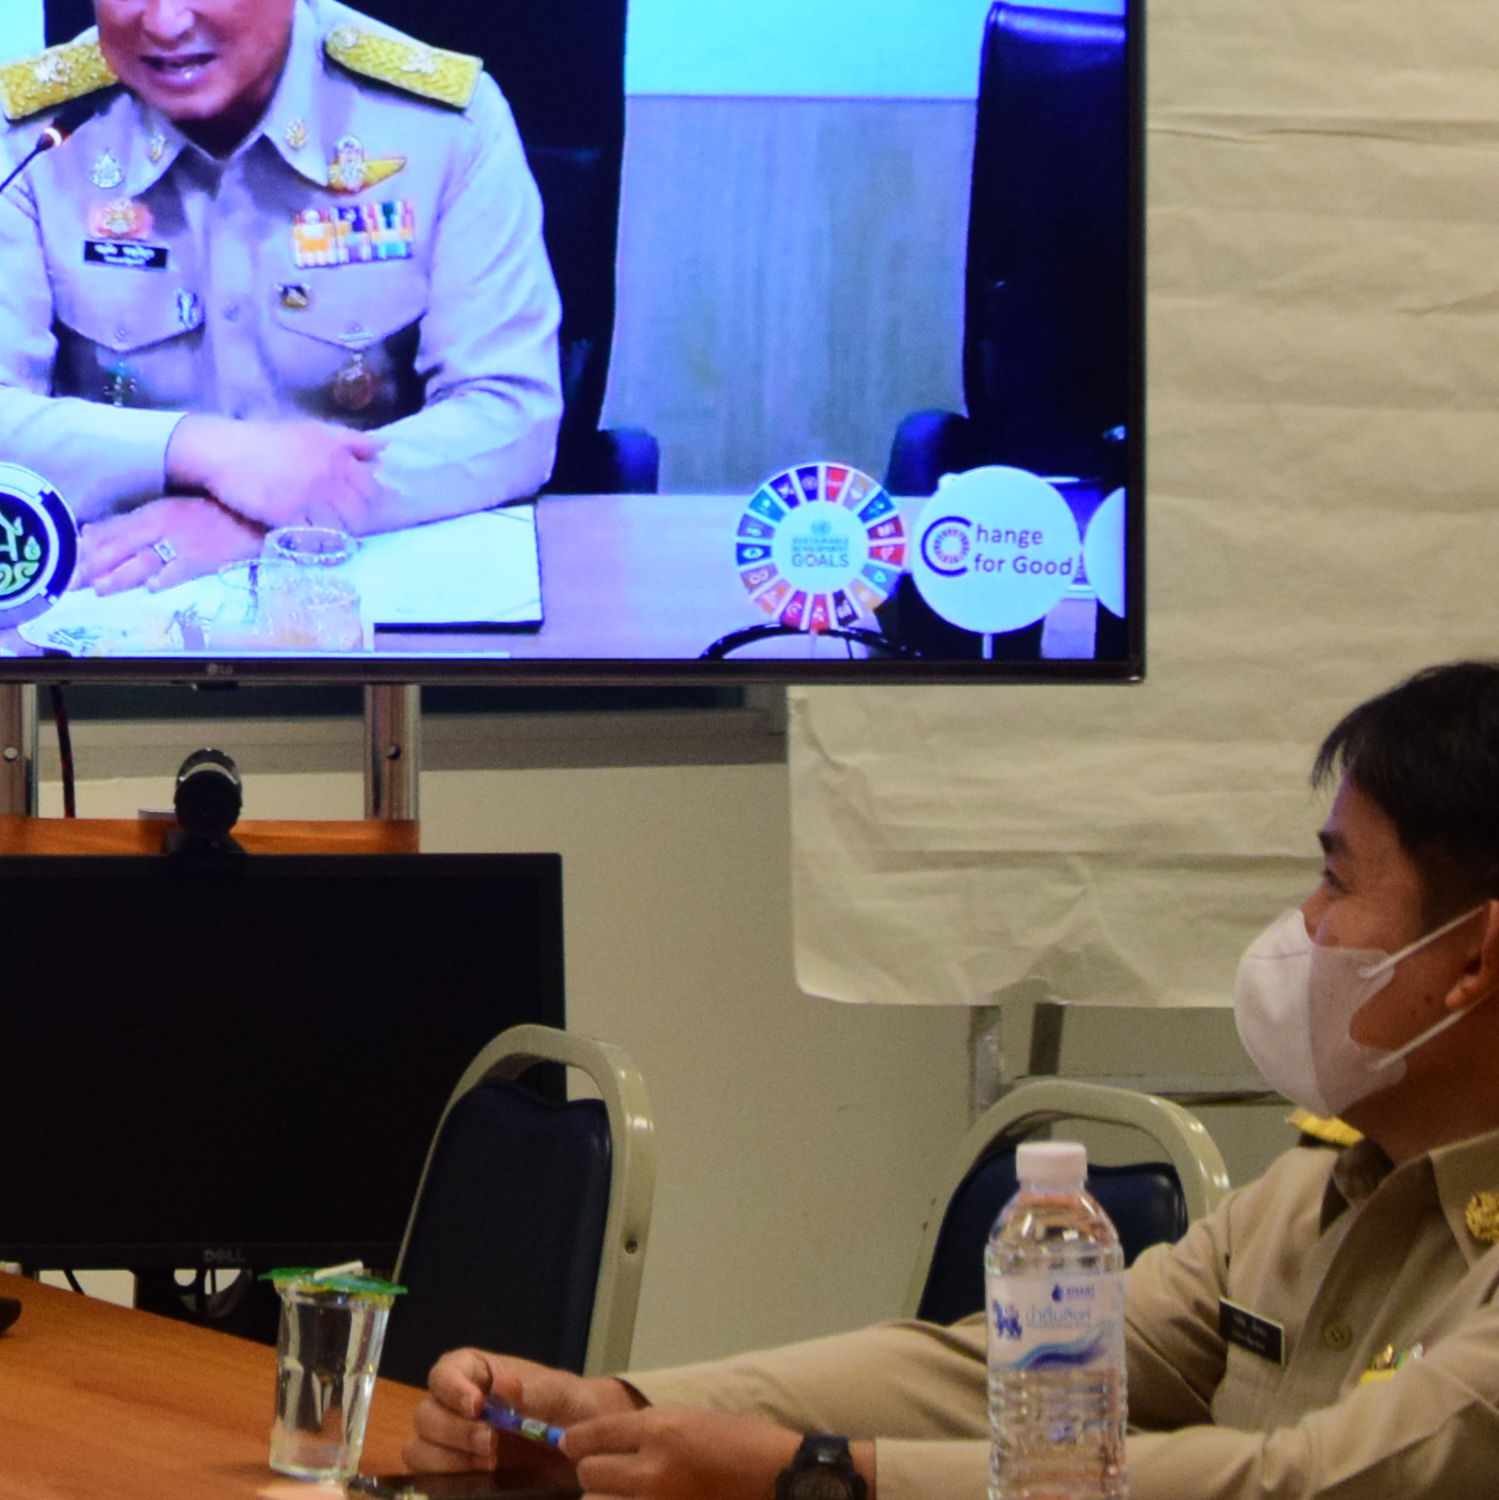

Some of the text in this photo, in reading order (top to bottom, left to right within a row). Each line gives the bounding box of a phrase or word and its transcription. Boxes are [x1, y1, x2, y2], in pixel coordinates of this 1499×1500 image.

[791, 553, 849, 568] GOALS
[974, 553, 1073, 576] for Good
[203, 1249, 246, 1263] DELL
